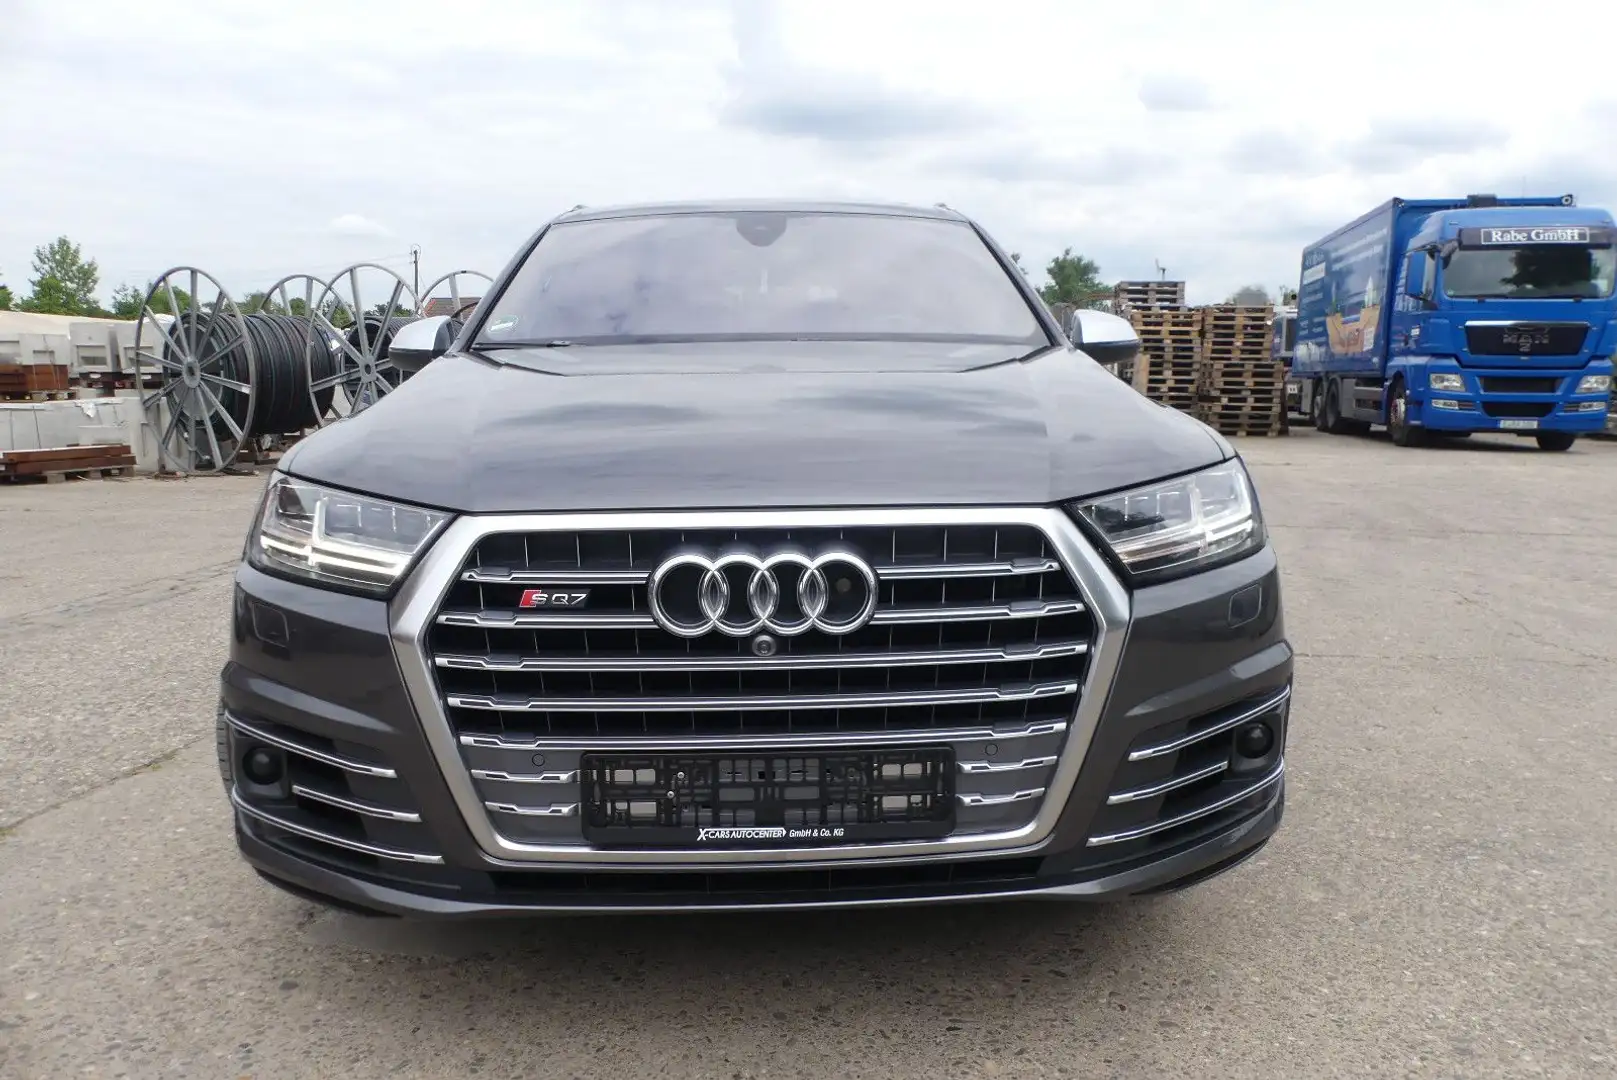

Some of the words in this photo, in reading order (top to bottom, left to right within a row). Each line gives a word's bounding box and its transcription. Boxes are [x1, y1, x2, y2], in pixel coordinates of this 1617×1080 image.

[1492, 230, 1528, 242] Rabe
[1531, 229, 1580, 241] GmbH
[527, 592, 588, 605] SQ7
[730, 829, 783, 838] AUTOCENTER
[789, 829, 811, 837] GmbH
[812, 829, 819, 837] &
[820, 828, 831, 837] Co.
[833, 828, 844, 837] KG
